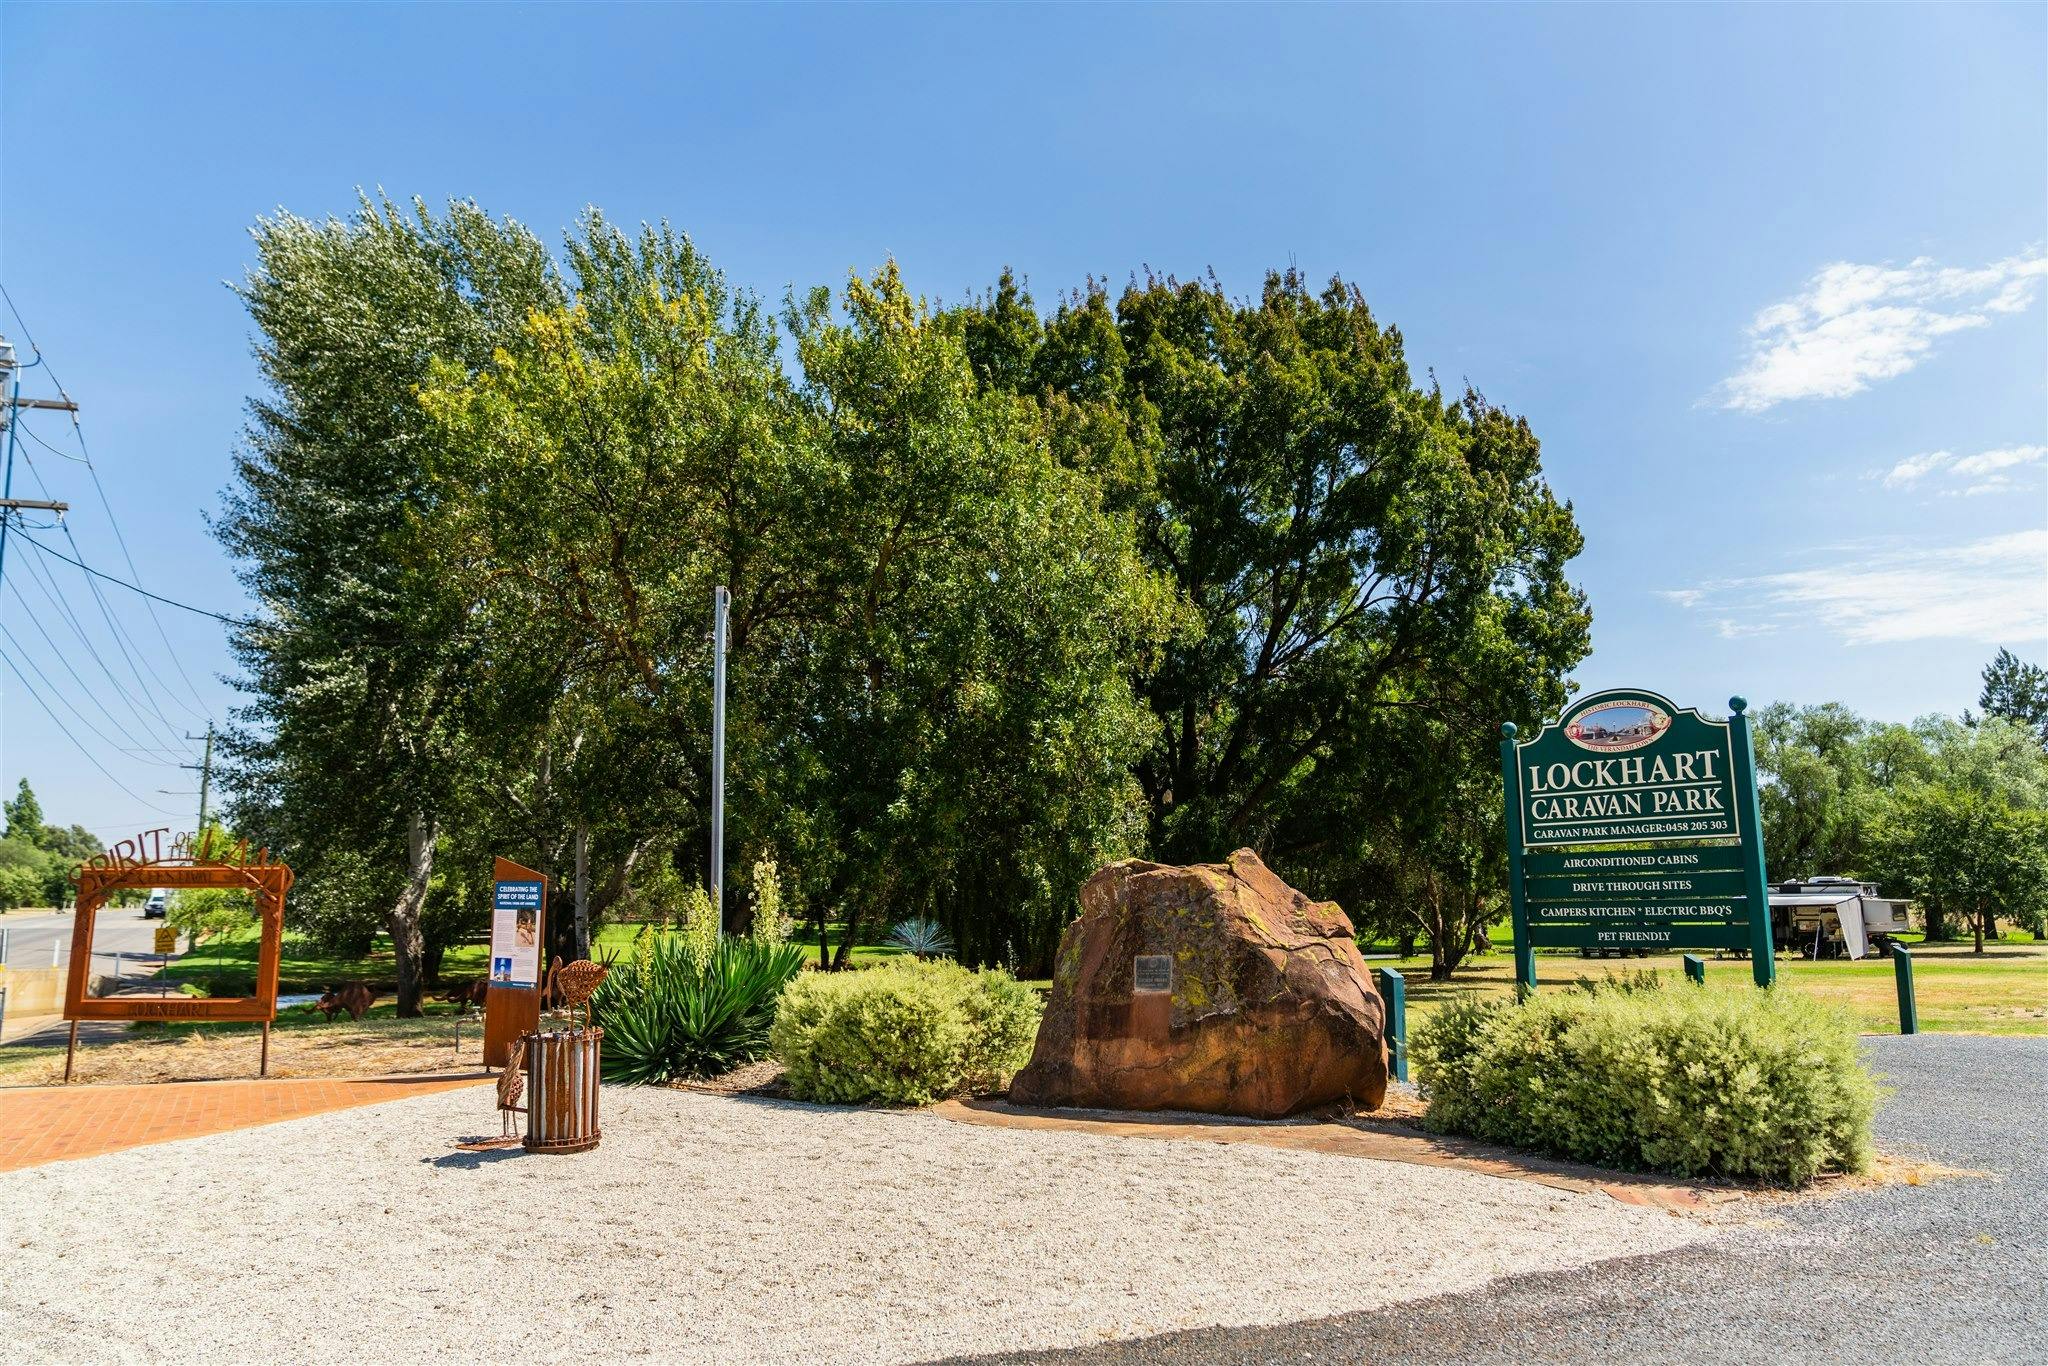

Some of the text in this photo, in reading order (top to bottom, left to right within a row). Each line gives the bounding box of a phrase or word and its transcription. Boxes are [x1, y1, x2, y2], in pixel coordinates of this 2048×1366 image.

[1580, 700, 1651, 717] HISTORIC LOCKHART
[1600, 743, 1634, 753] VERANDAH
[1635, 738, 1654, 749] TOWN
[1529, 749, 1720, 792] LOCKHART
[1531, 787, 1724, 820] CARAVAN PARK
[1533, 828, 1580, 839] CARAVAN
[1582, 826, 1609, 837] PARK
[1690, 821, 1709, 831] 205
[1710, 820, 1728, 830] 303
[1563, 854, 1698, 868] AIRCONDITIONED CABINS
[1572, 880, 1692, 892] DRIVE THROUGH SITES
[1541, 906, 1587, 917] CAMPERS
[1589, 906, 1636, 917] KITCHEN
[1644, 905, 1698, 916] ELECTRIC
[1597, 931, 1671, 942] PET FRIENDLY
